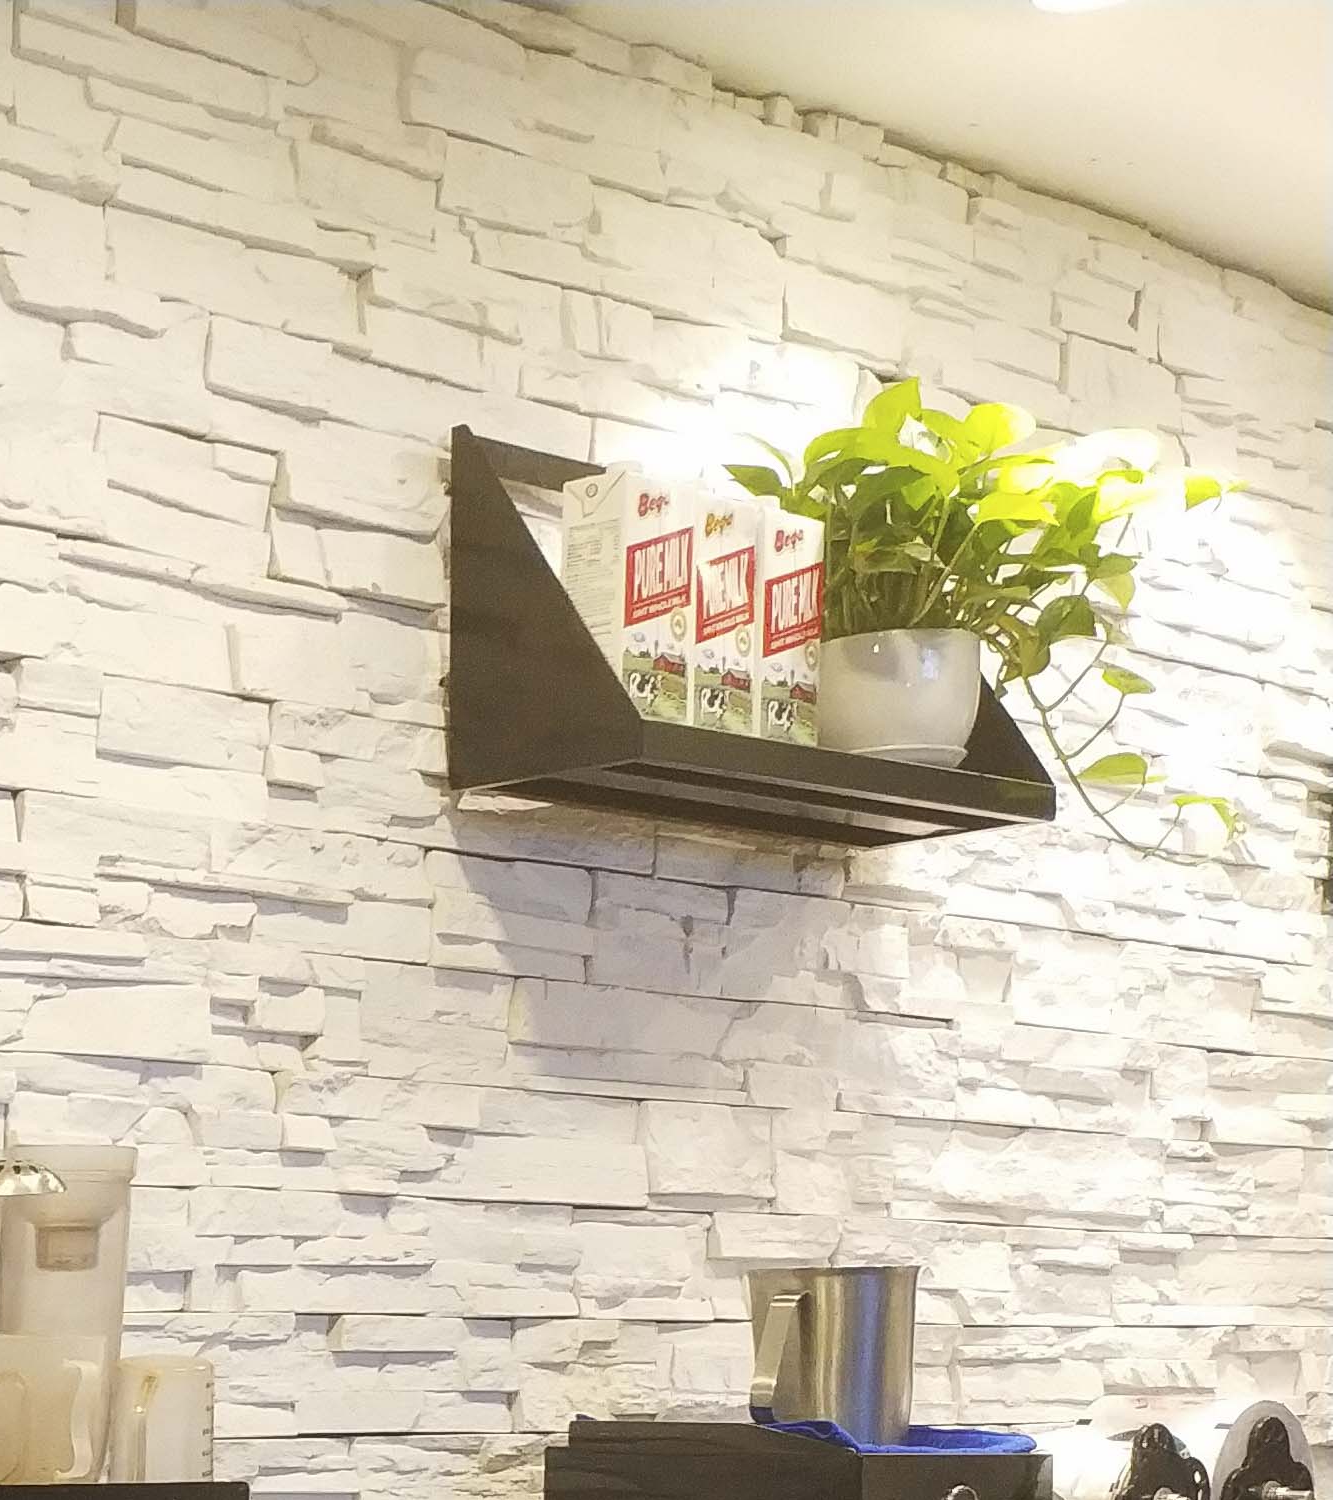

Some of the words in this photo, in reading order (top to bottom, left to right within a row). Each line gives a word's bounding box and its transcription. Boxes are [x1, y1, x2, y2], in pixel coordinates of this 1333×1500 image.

[633, 543, 664, 602] PURE
[664, 533, 690, 593] MILK
[770, 577, 799, 634] PURE
[799, 567, 820, 625] MILK
